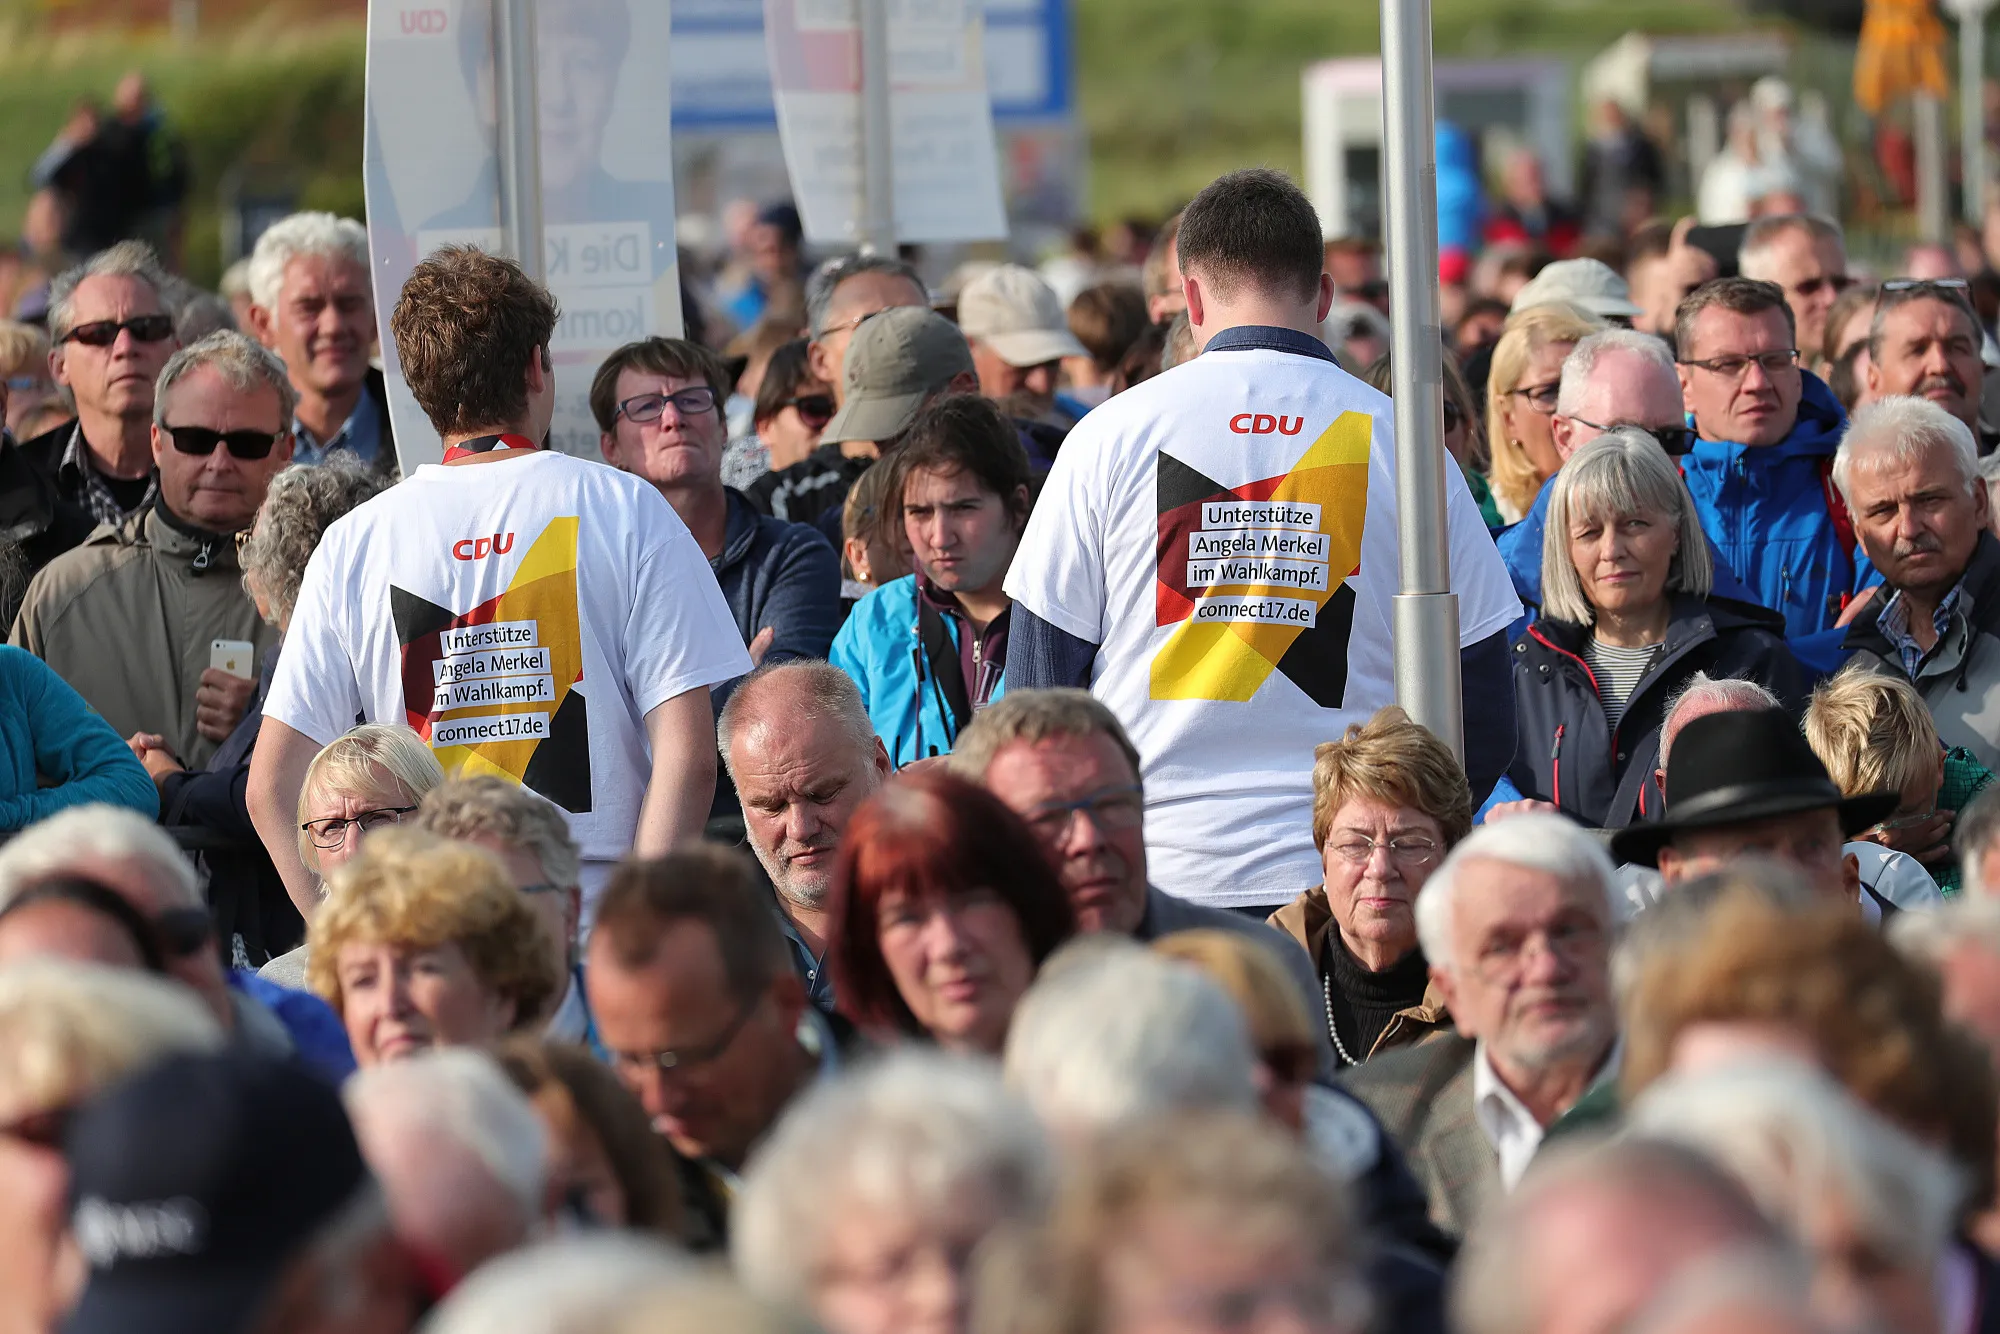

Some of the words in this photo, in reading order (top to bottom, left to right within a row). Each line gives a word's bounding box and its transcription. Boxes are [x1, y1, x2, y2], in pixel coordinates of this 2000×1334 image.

[1229, 413, 1304, 436] CDU
[1208, 506, 1314, 525] Unterstütze
[452, 532, 515, 561] CDU
[1195, 534, 1256, 556] Angela
[1261, 535, 1322, 556] Merkel
[1193, 565, 1215, 582] im
[1221, 563, 1321, 588] Wahlkampf.
[1198, 601, 1310, 622] connect17.de
[440, 656, 485, 681] Angela
[491, 651, 544, 672] Merkel
[454, 679, 548, 702] Wahlkampf.
[437, 716, 543, 742] connect17.de
